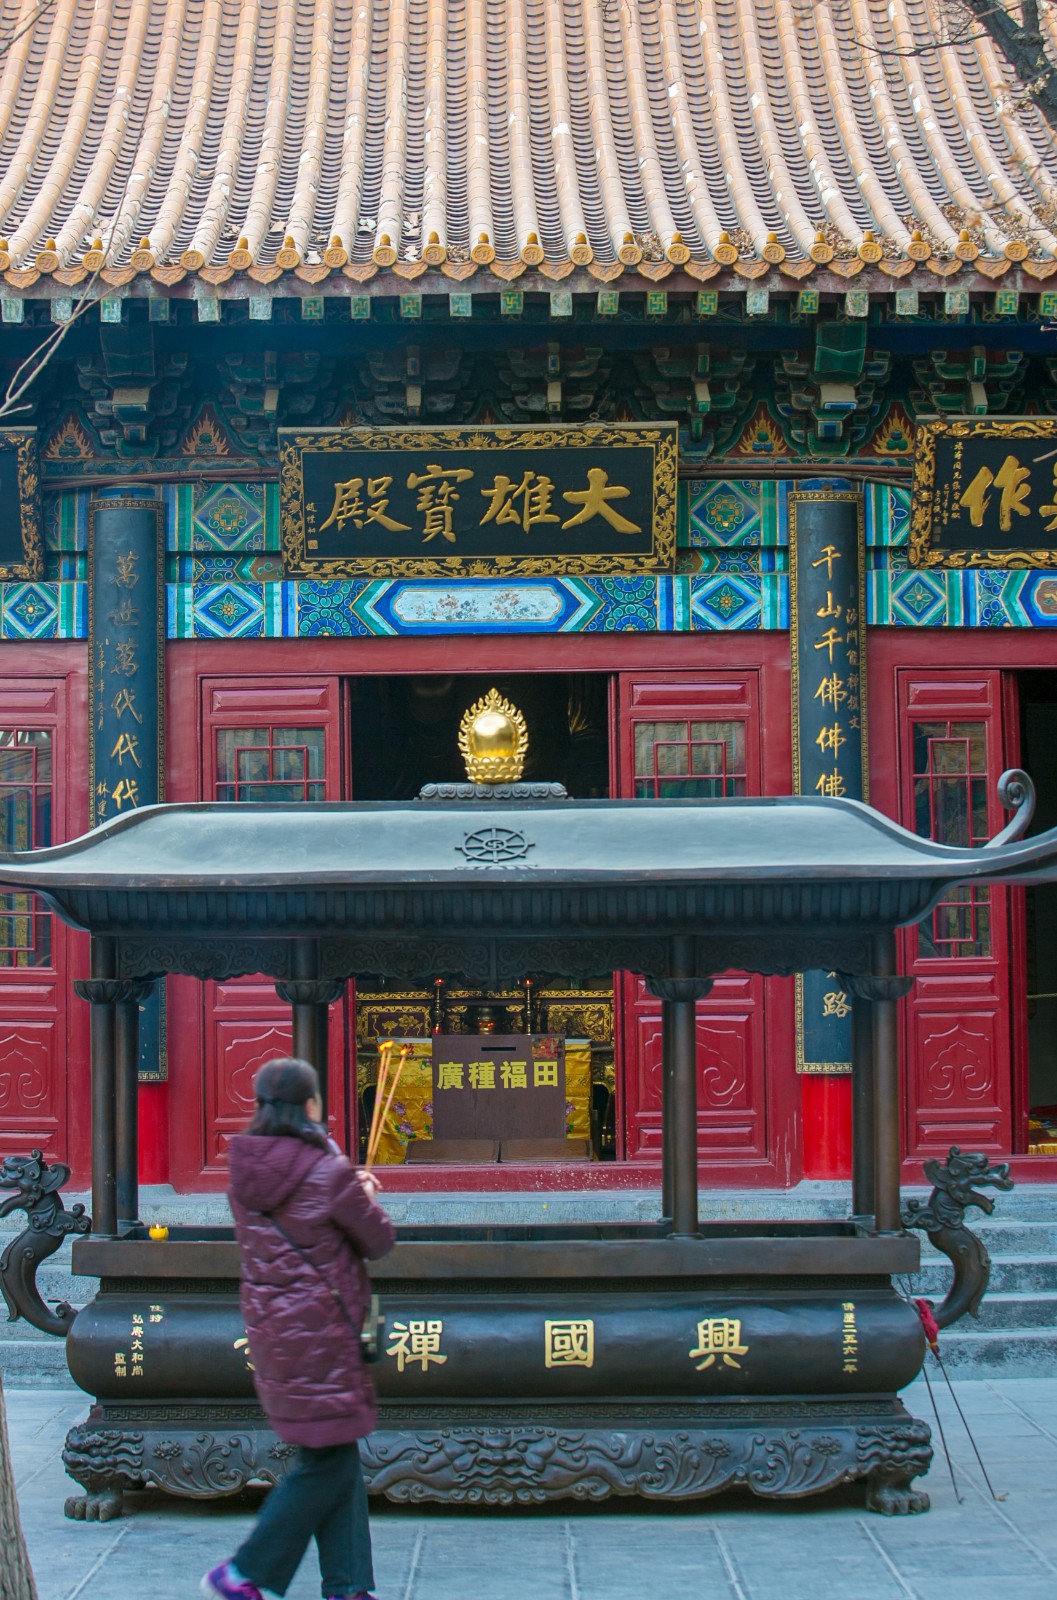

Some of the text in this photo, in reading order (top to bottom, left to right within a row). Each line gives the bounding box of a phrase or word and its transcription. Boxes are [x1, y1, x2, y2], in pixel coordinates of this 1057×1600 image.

[319, 464, 642, 544] 大雄寶殿
[812, 544, 848, 798] 千山千佛佛佛
[437, 1060, 559, 1090] 廣種福田
[149, 1304, 164, 1324] 住持
